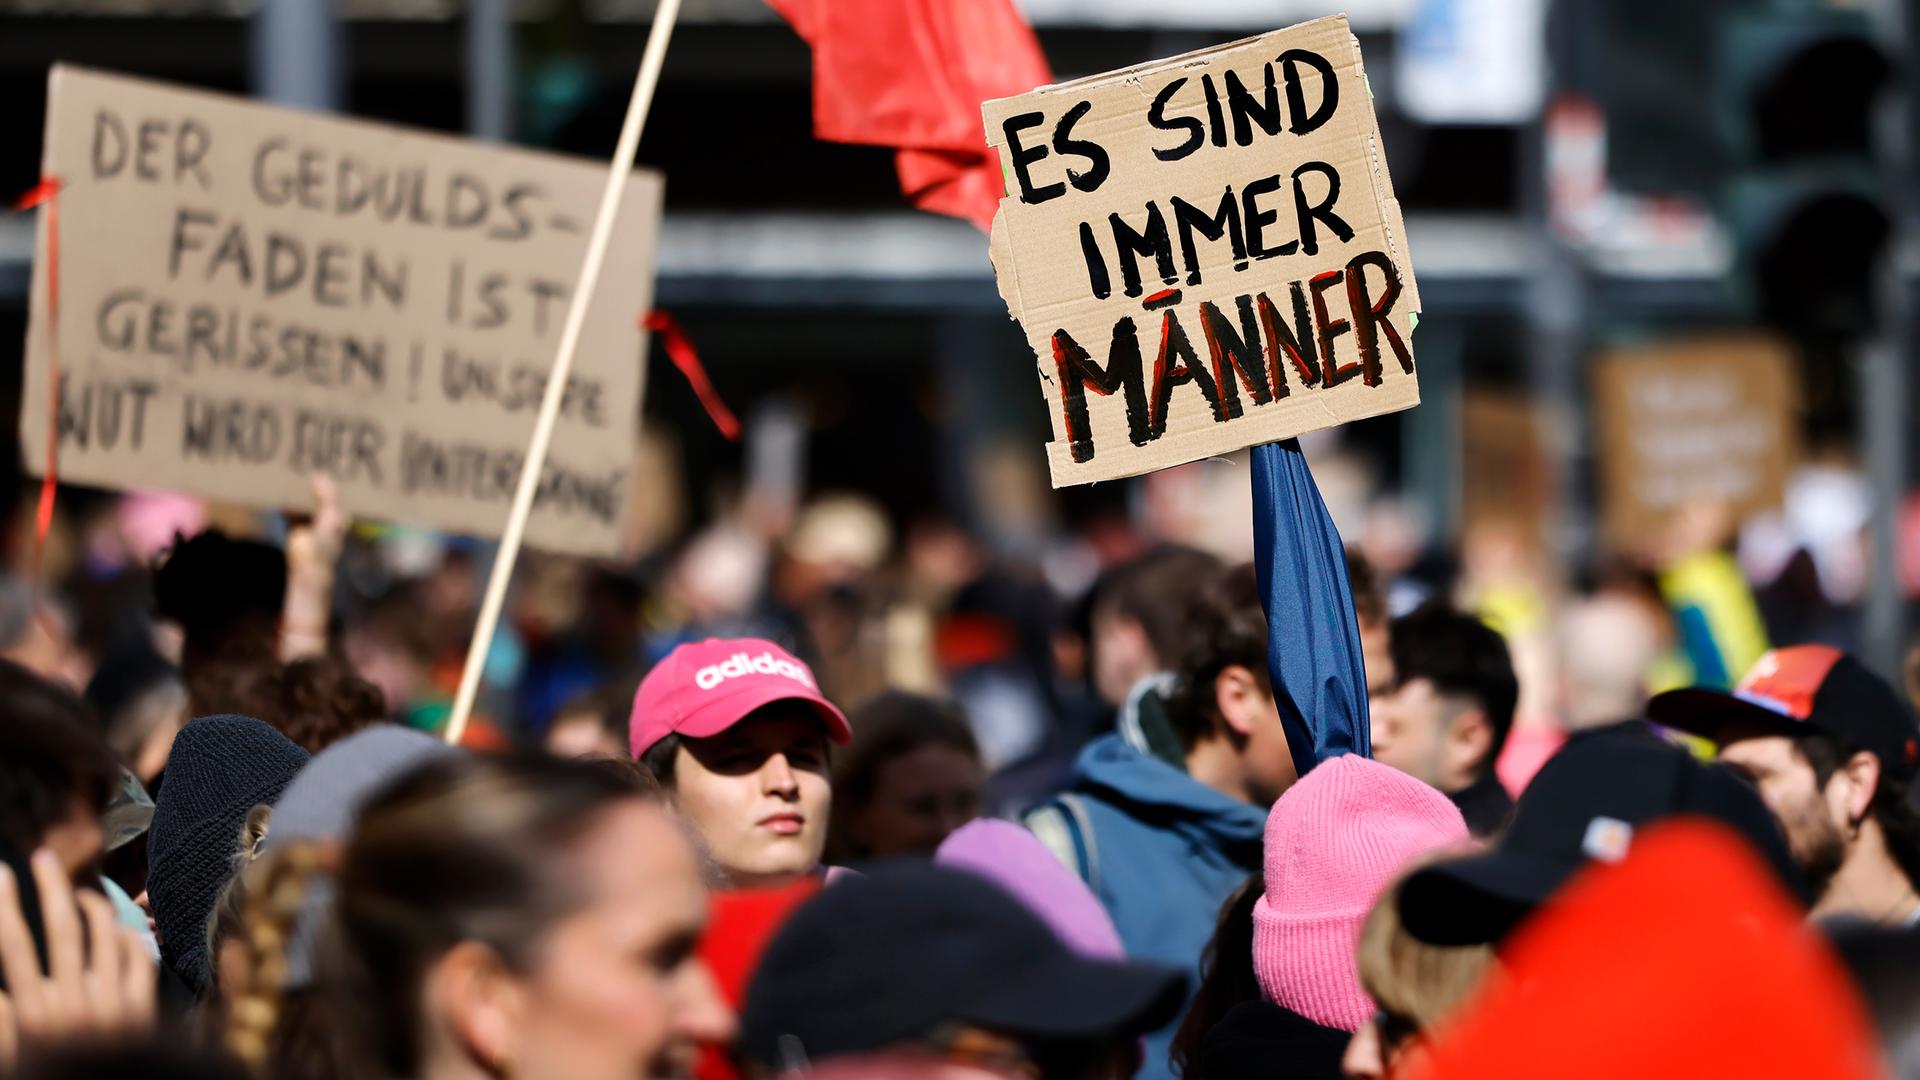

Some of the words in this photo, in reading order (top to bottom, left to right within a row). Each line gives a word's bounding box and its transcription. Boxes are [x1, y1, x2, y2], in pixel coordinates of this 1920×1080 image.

[90, 110, 211, 189] DER
[251, 137, 580, 240] GEDULDS-
[1003, 101, 1110, 204] ES
[1148, 48, 1339, 161] SIND
[167, 207, 409, 310] FADEN
[446, 257, 571, 338] IST
[1079, 161, 1355, 300] IMMER
[97, 290, 387, 393] GERISSEN
[1051, 251, 1414, 463] MÄNNER
[58, 370, 158, 454] WUT
[181, 395, 281, 466] WIRD
